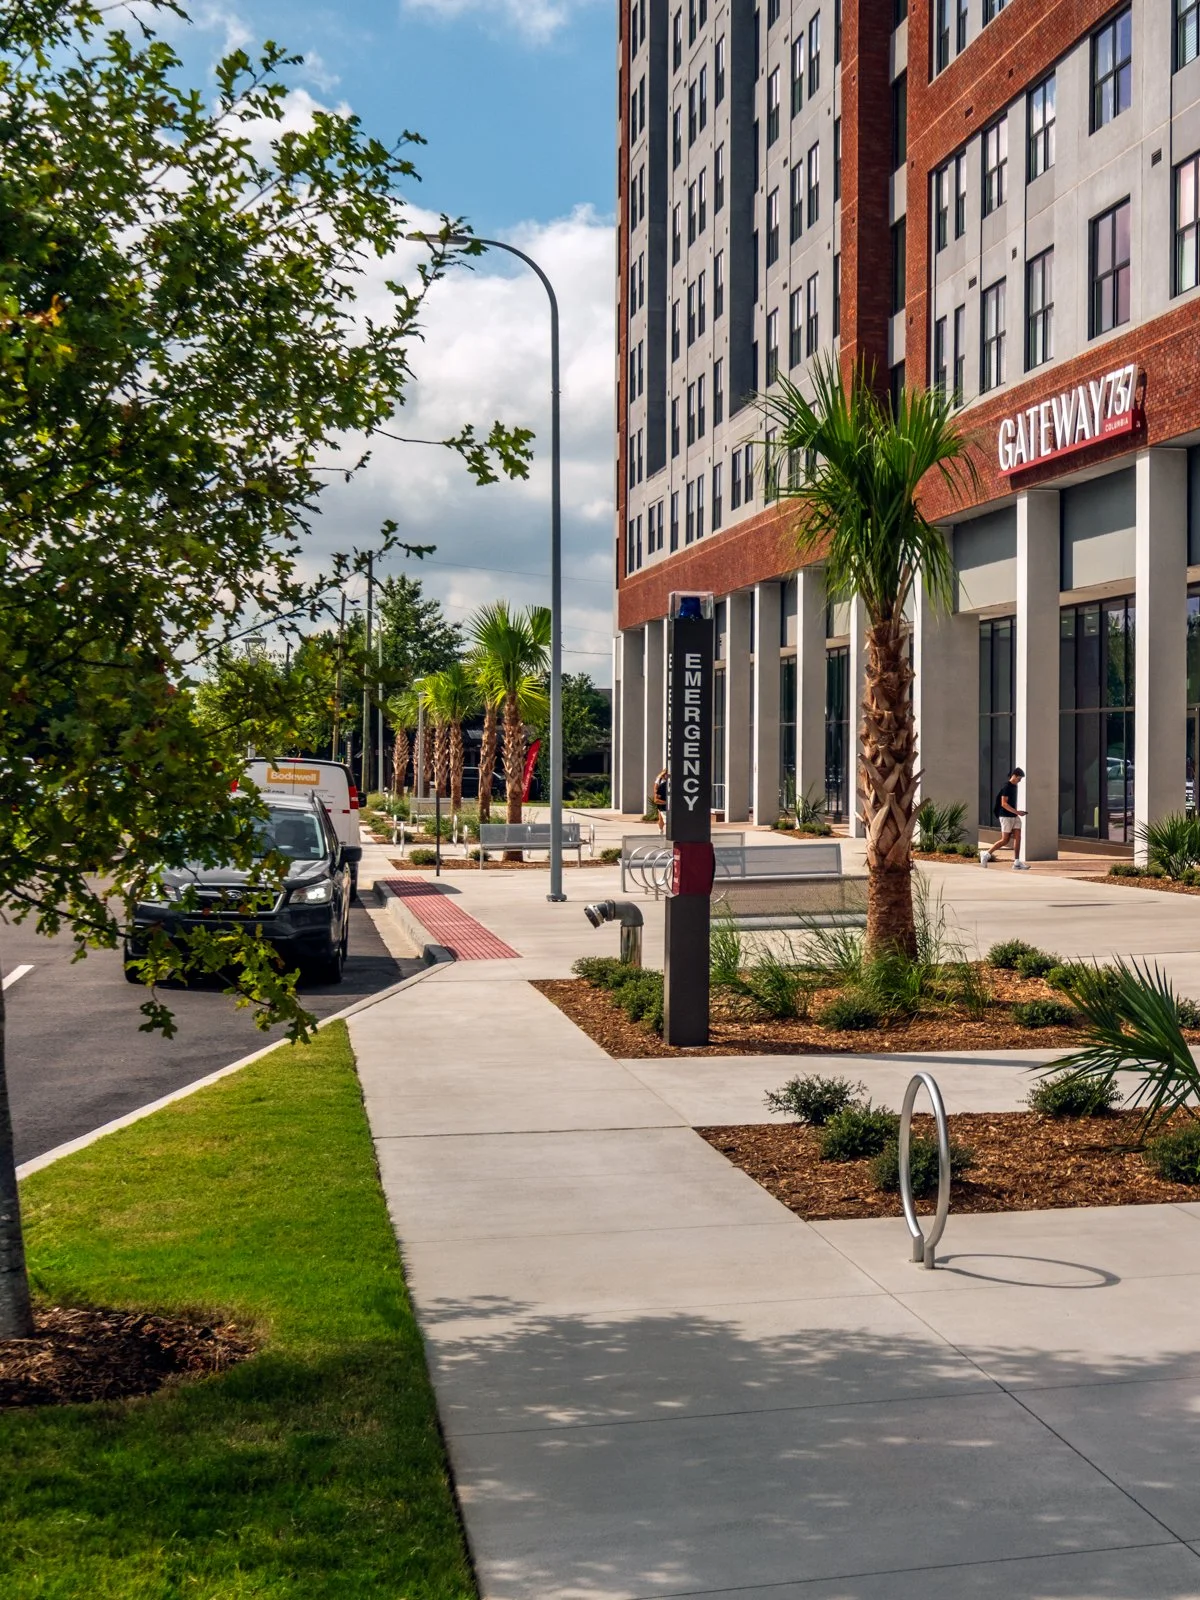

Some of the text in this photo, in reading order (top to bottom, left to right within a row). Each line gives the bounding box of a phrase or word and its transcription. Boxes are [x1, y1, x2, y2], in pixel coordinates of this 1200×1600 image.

[998, 376, 1104, 471] GATEWAY
[1105, 417, 1129, 433] COLUMBIA
[683, 653, 702, 811] EMERGENCY
[270, 771, 317, 782] Bodewell
